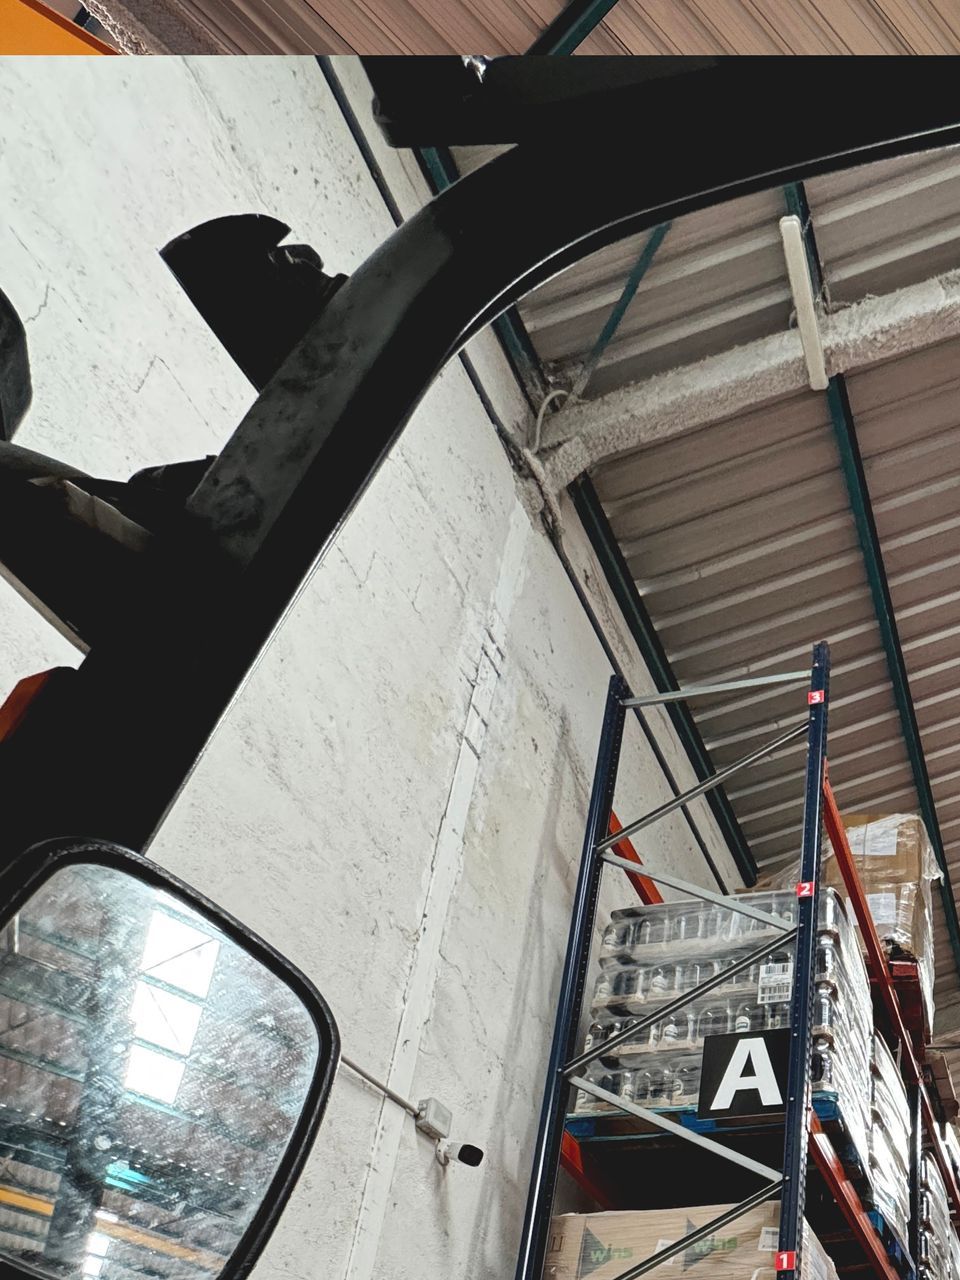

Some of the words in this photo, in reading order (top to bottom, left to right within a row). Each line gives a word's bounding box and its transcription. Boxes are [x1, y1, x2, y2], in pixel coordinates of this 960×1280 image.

[811, 692, 821, 703] 3
[800, 883, 811, 896] 2
[709, 1037, 784, 1111] A
[779, 1254, 788, 1268] 1
